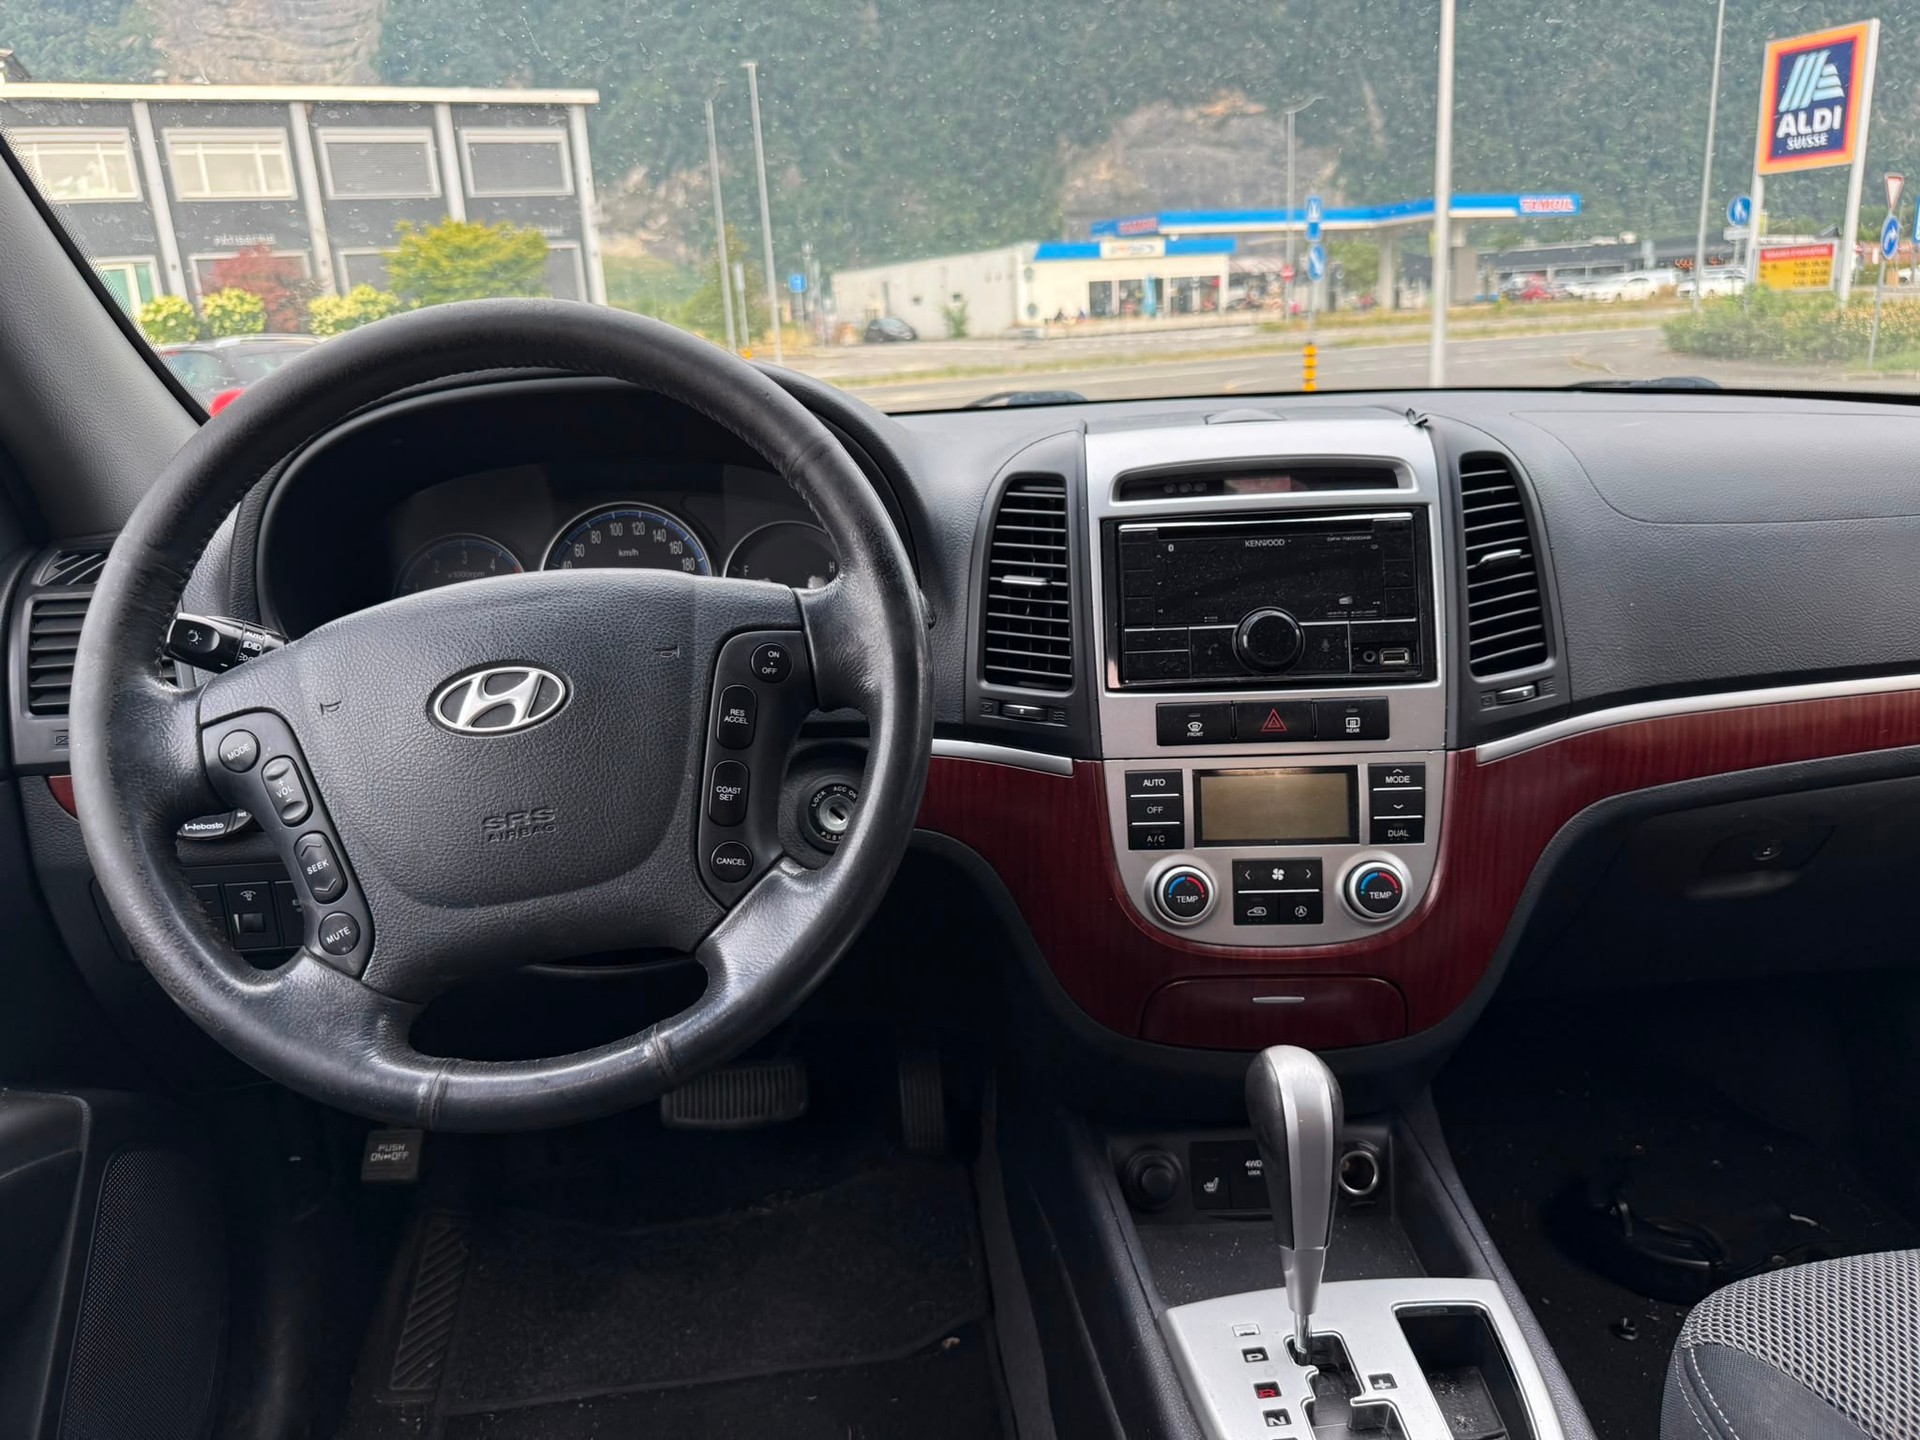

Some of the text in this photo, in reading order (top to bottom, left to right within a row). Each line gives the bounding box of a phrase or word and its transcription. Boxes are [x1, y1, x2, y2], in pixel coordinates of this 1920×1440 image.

[1776, 105, 1843, 139] ALDI
[1786, 132, 1829, 151] SUISSE
[609, 523, 623, 536] 100
[632, 522, 646, 536] 120
[591, 530, 602, 544] 80
[652, 529, 667, 543] 140
[669, 541, 684, 555] 160
[1244, 539, 1285, 548] KENWOOD
[574, 543, 585, 557] 60
[618, 548, 639, 557] km/h
[461, 550, 468, 565] 3
[434, 561, 440, 574] 2
[490, 557, 496, 572] 4
[681, 557, 696, 571] 180
[829, 561, 836, 573] H
[743, 565, 749, 577] F
[767, 650, 780, 658] ON
[761, 667, 778, 675] OFF
[730, 708, 745, 717] RES
[723, 715, 749, 725] ACCEL
[226, 743, 252, 761] MODE
[1143, 778, 1166, 787] AUTO
[1385, 775, 1411, 784] MODE
[276, 785, 294, 798] VOL
[716, 785, 742, 795] COAST
[833, 785, 847, 793] ACC
[719, 793, 735, 801] SET
[811, 791, 827, 807] LOCK
[1146, 806, 1164, 814] OFF
[482, 808, 556, 832] SRS
[184, 822, 225, 831] Webasto
[487, 825, 557, 842] AIRBAG
[1387, 829, 1410, 838] DUAL
[716, 857, 748, 866] CANCEL
[306, 859, 330, 875] SEEK
[1176, 895, 1199, 904] TEMP
[1369, 891, 1392, 900] TEMP
[326, 926, 351, 945] MUTE
[378, 1144, 406, 1152] PUSH
[1245, 1159, 1263, 1168] 4WD
[1246, 1353, 1264, 1362] D
[1258, 1389, 1276, 1398] R
[1267, 1418, 1287, 1427] N
